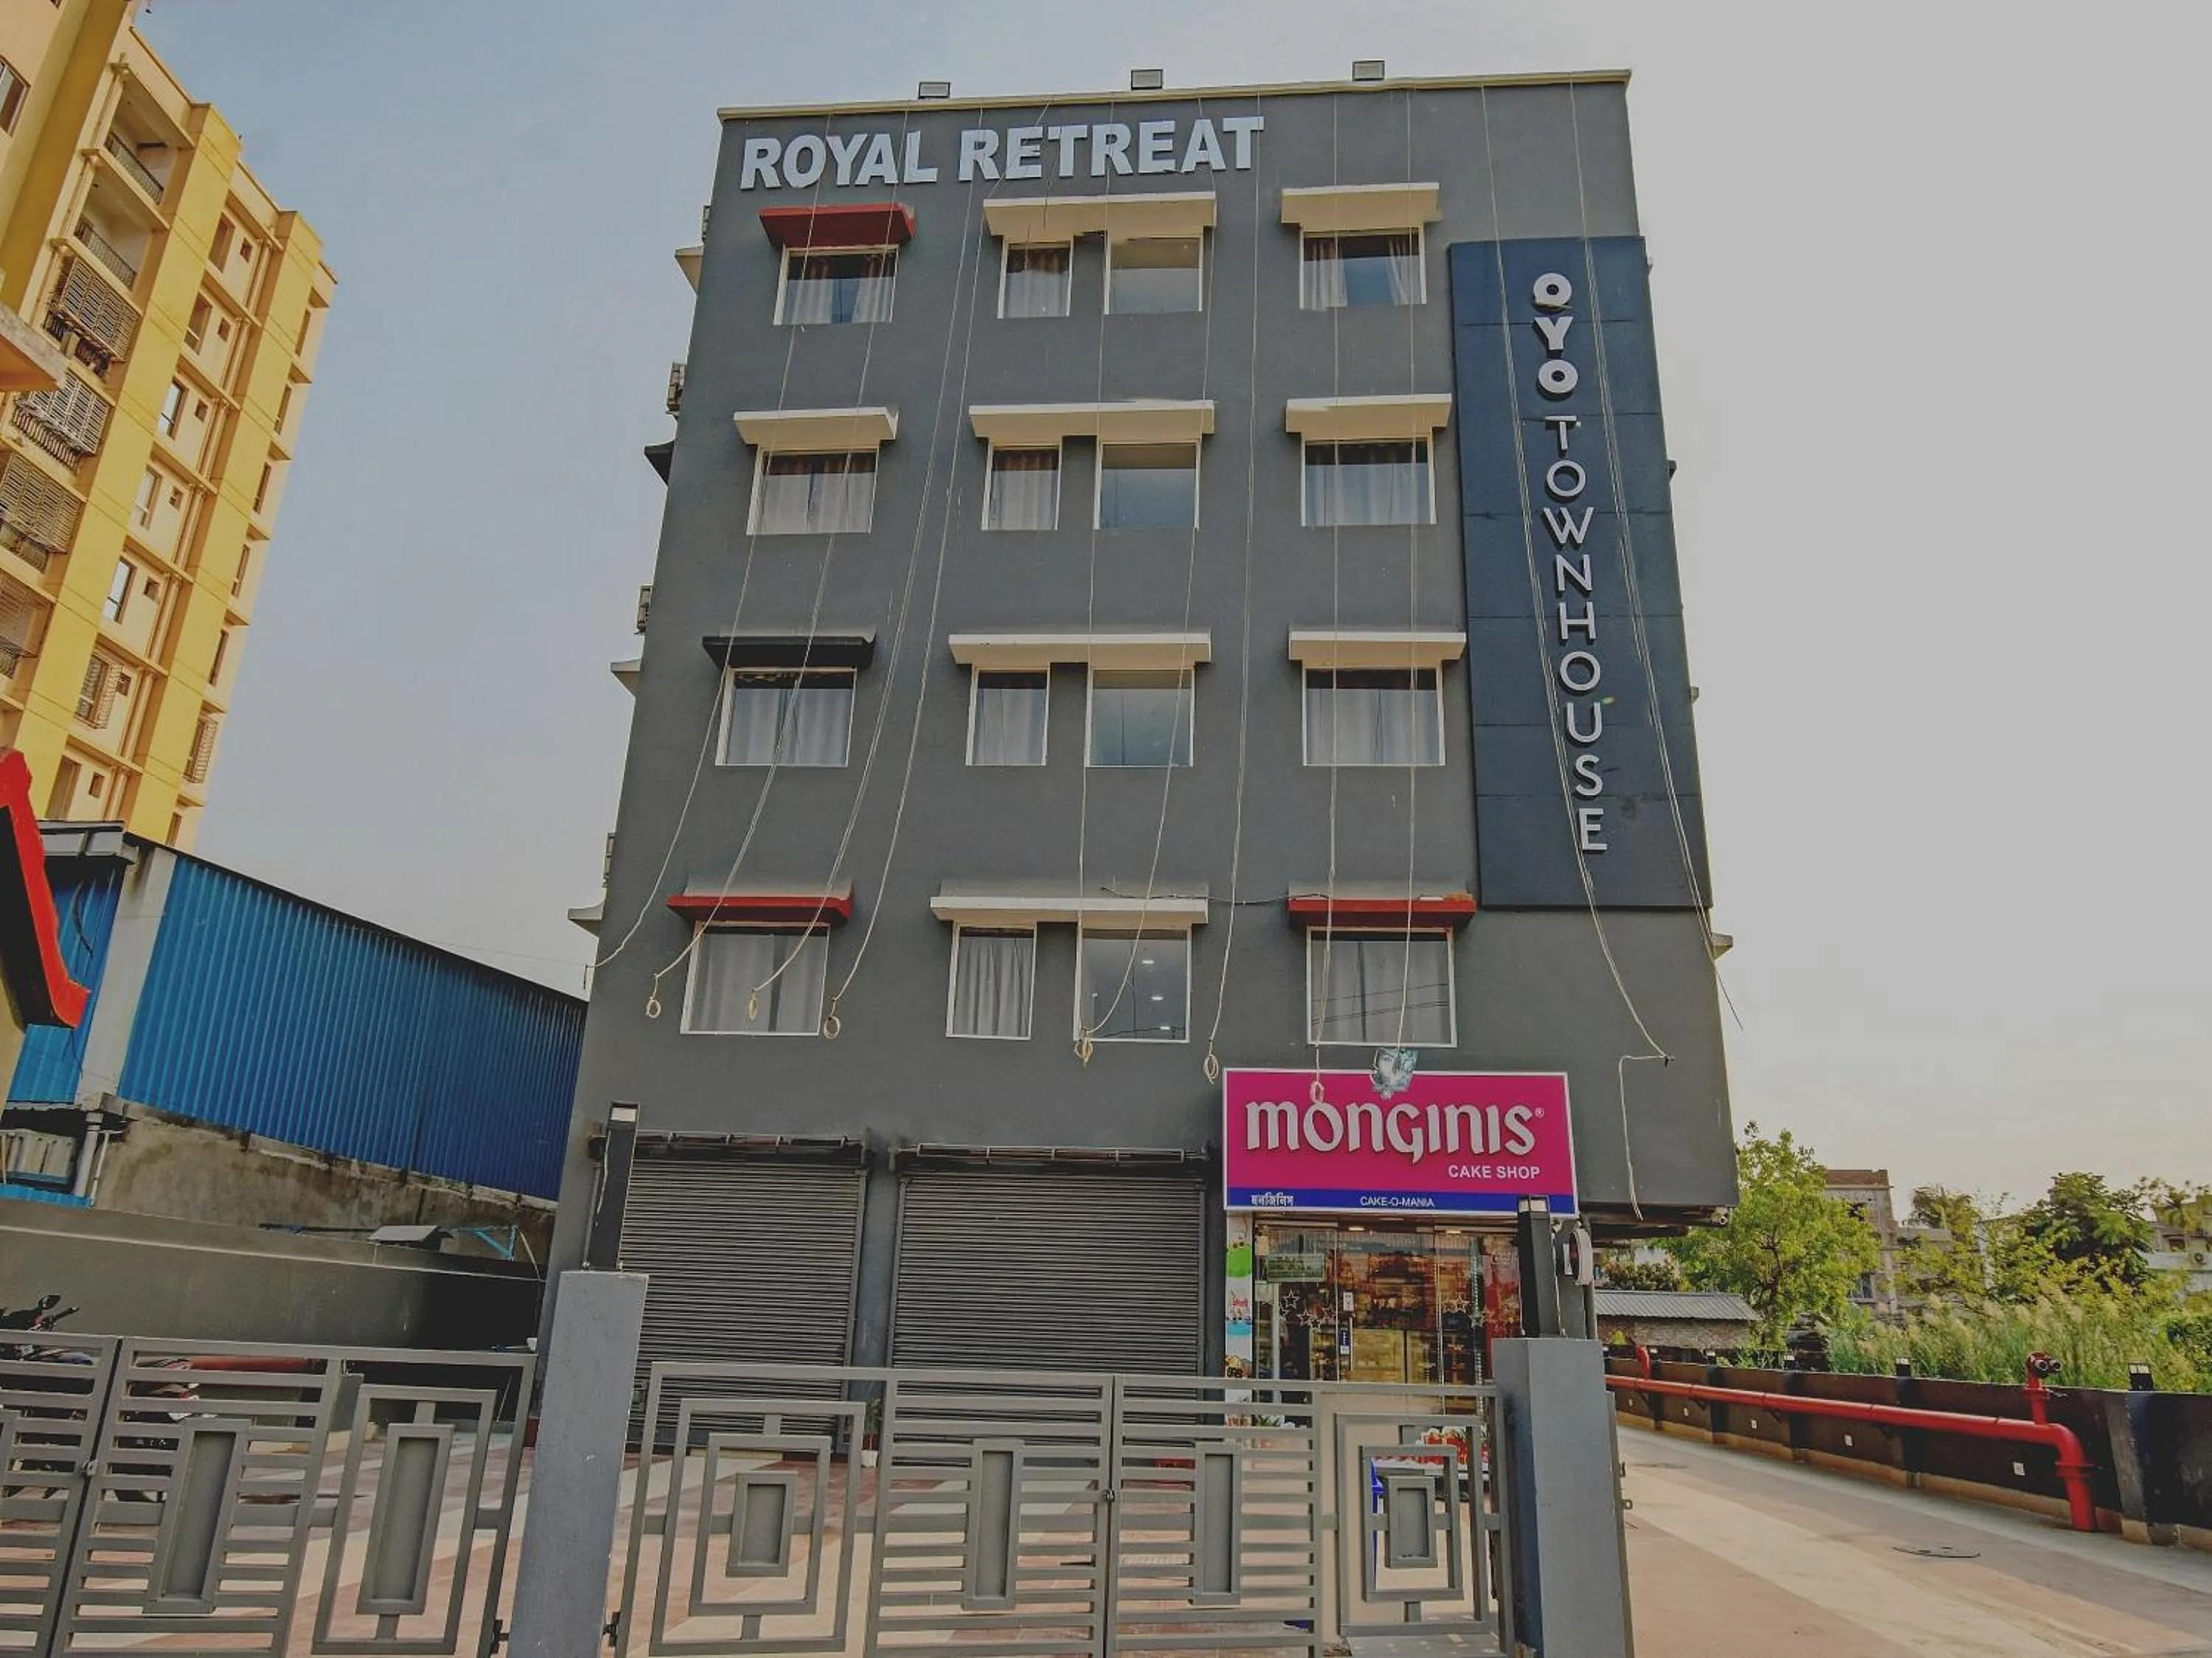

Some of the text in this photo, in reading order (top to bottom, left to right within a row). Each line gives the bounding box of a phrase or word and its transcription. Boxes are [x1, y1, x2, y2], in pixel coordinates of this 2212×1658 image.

[740, 117, 1264, 189] ROYAL RETREAT
[1533, 273, 1607, 852] OYO TOWNHOUSE
[1448, 1164, 1540, 1179] CAKE SHOP
[1360, 1196, 1435, 1207] CAKE-O-MANIA
